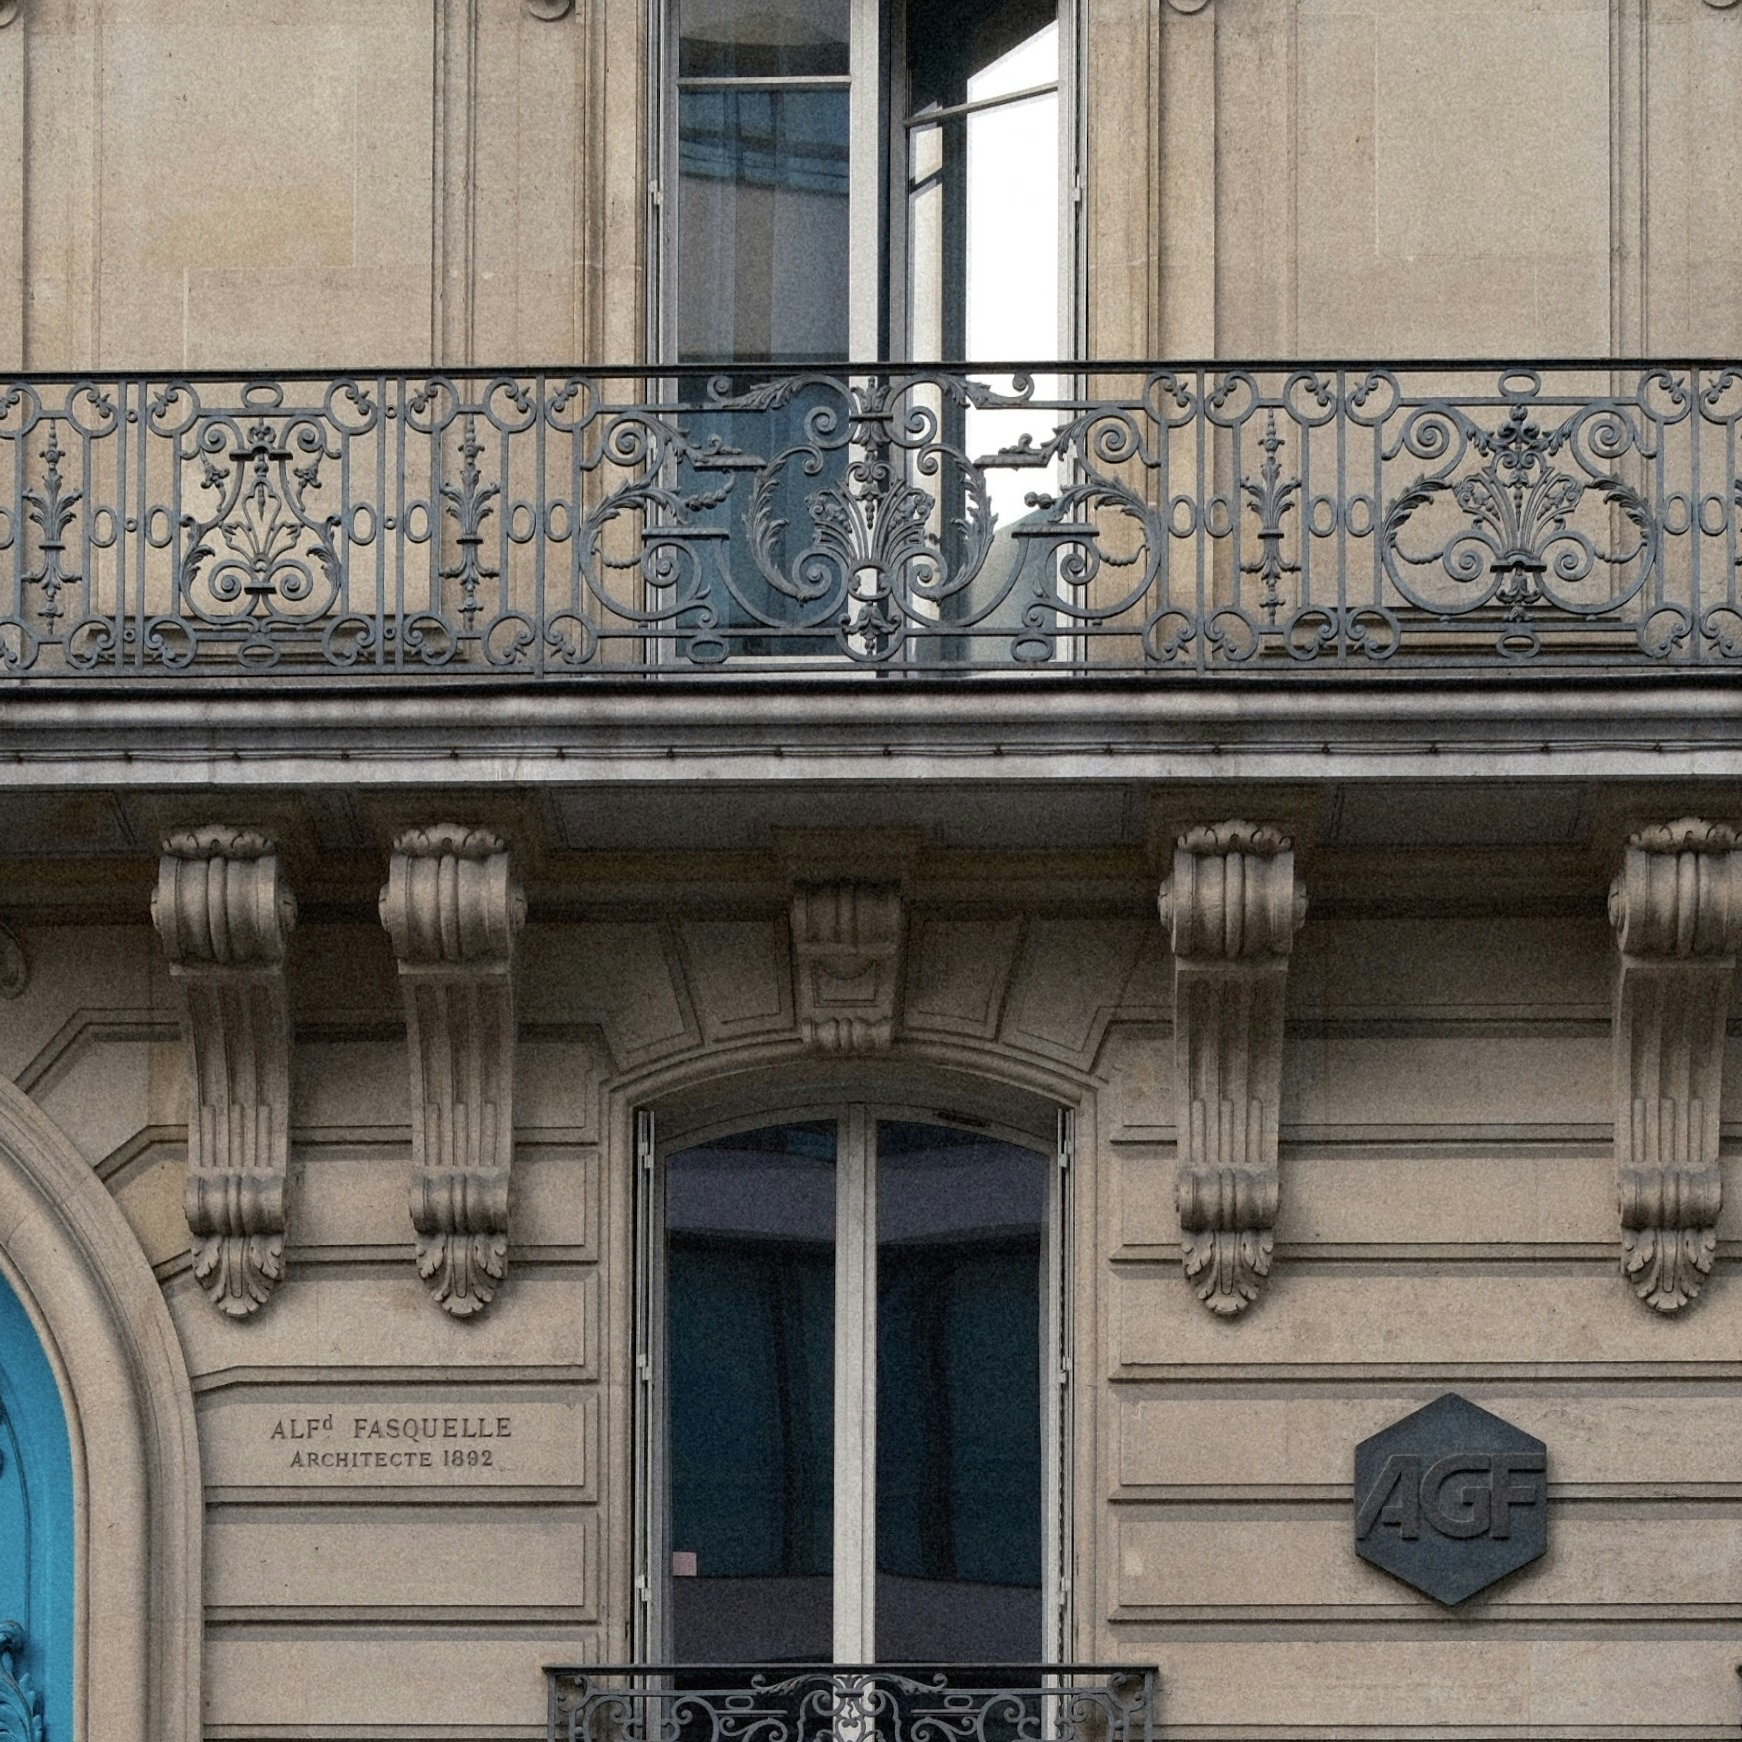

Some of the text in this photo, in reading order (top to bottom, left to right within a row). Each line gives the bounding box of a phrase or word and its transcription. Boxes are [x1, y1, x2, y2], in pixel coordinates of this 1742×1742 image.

[353, 1417, 512, 1443] FASQUELLE
[289, 1449, 494, 1468] ARCHITECTE 1892
[1355, 1452, 1547, 1541] AGF
